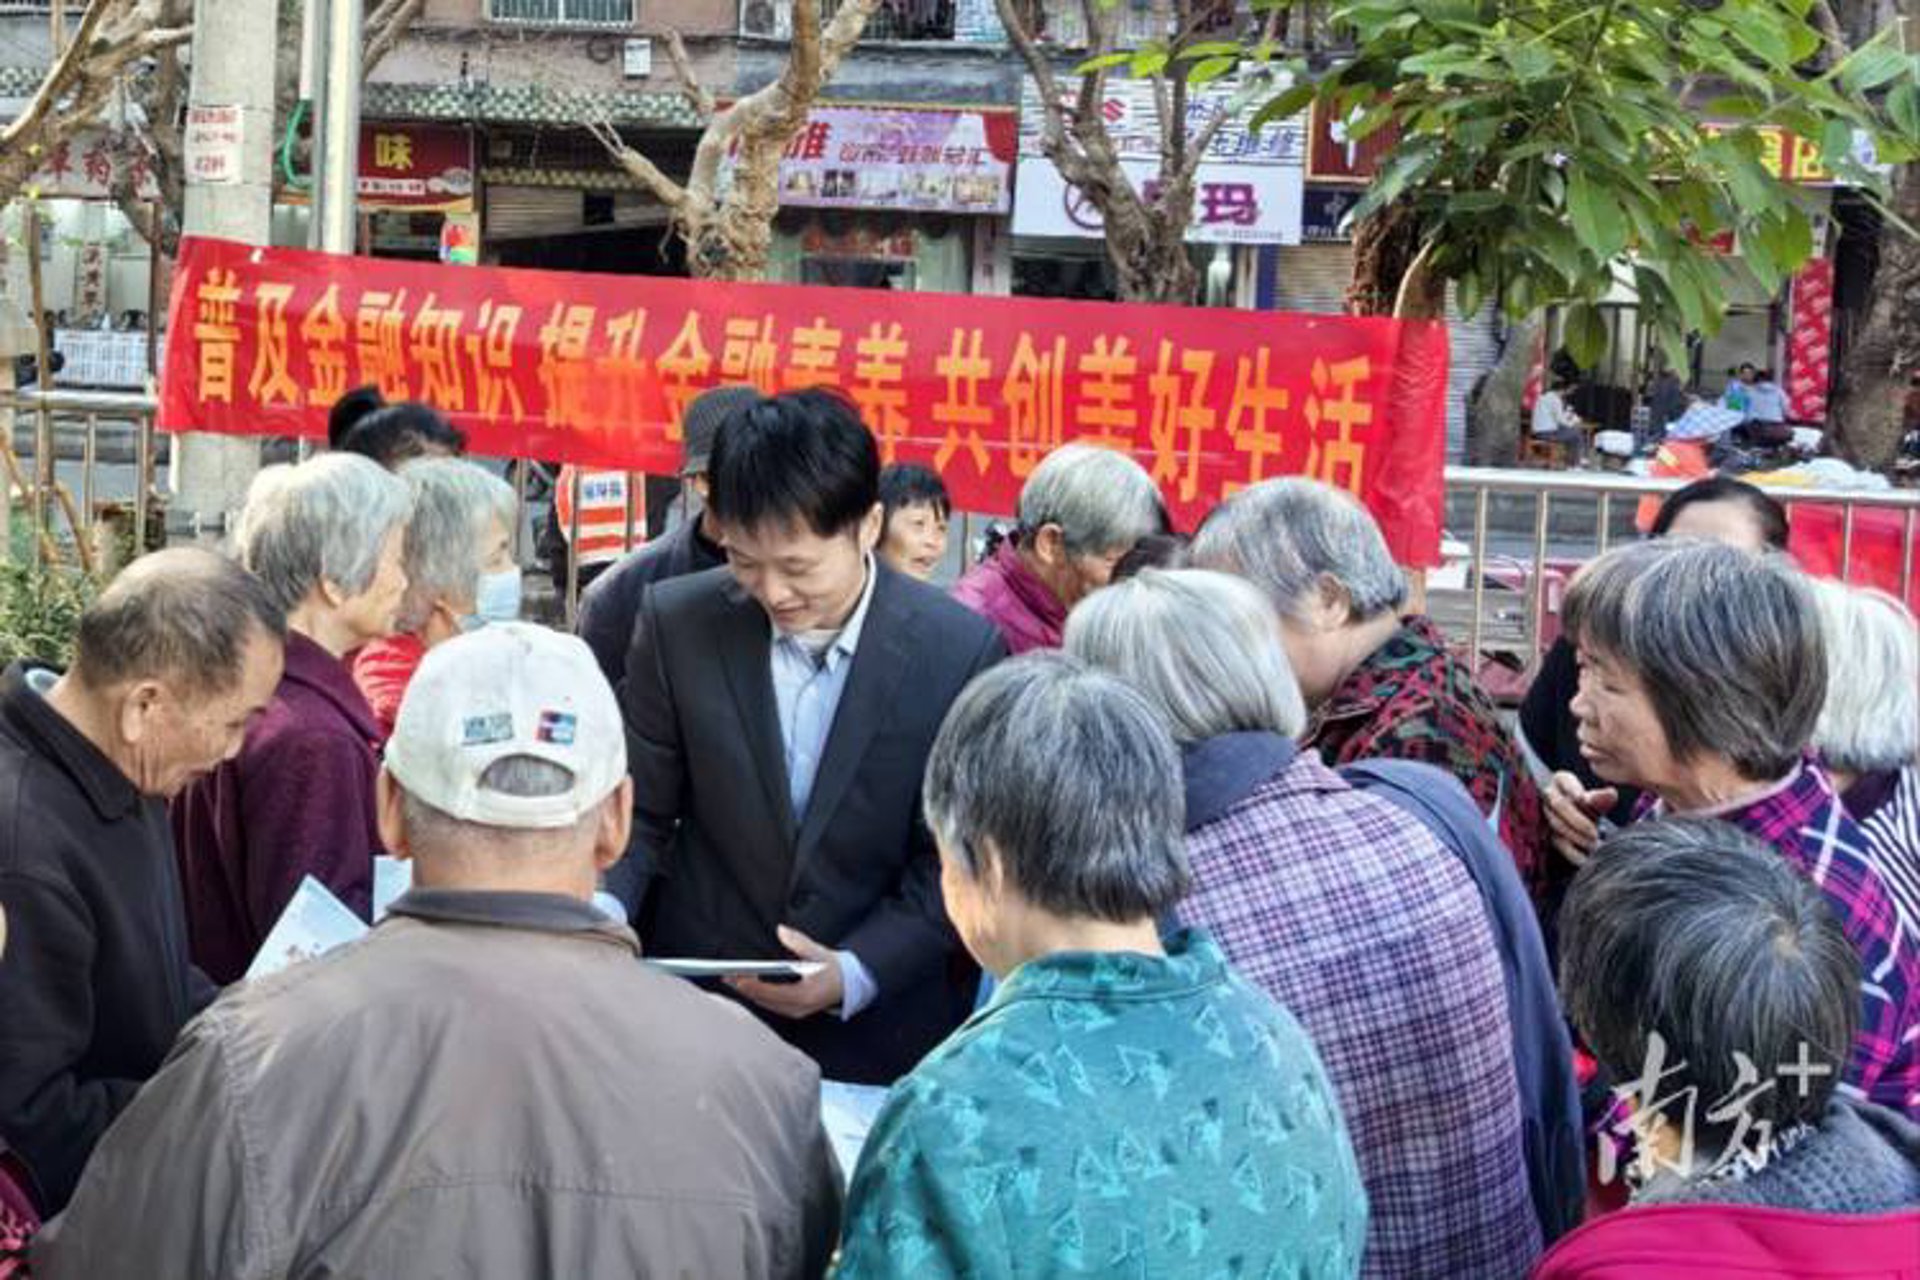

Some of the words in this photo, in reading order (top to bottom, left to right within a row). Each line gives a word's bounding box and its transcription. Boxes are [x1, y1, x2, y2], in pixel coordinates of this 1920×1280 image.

[375, 134, 413, 169] 味
[1201, 183, 1261, 226] 玛
[193, 268, 523, 421] 普及金融知识
[932, 327, 1376, 503] 共创美好生活
